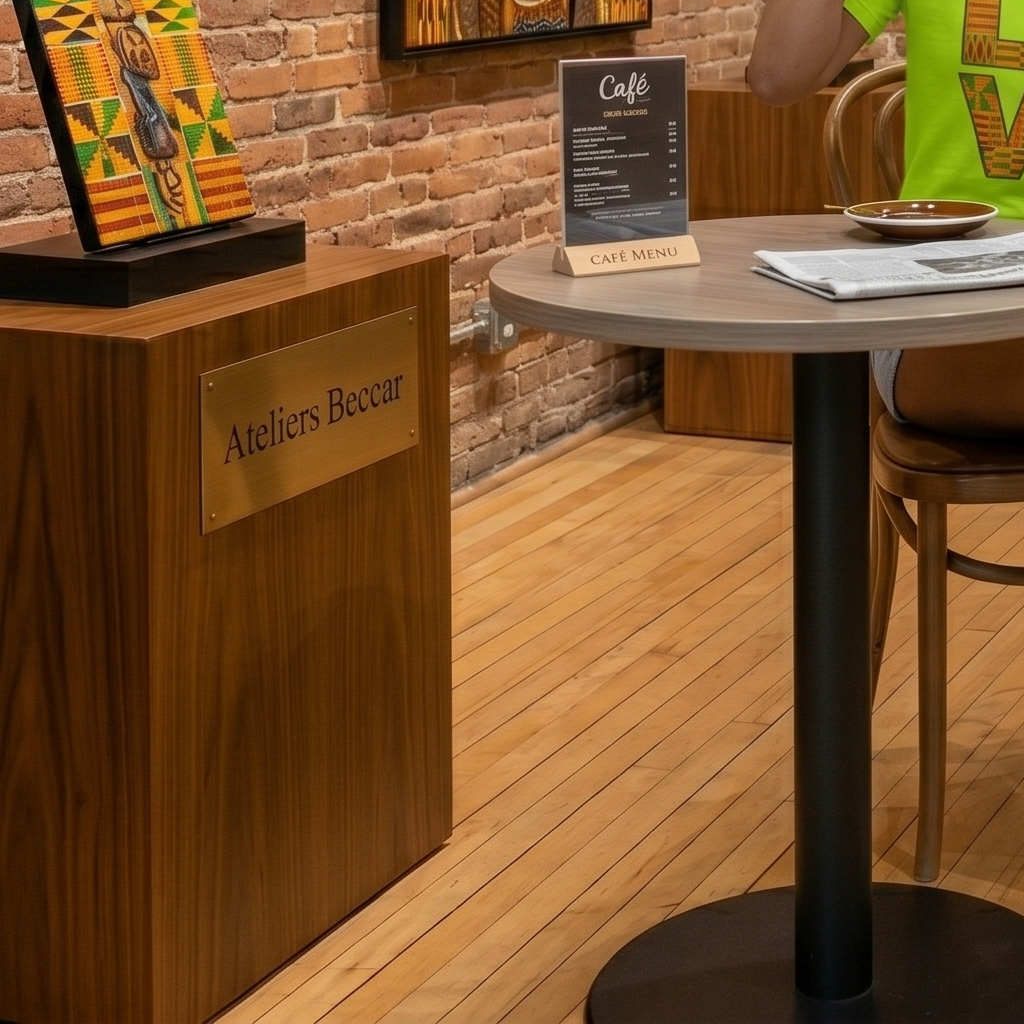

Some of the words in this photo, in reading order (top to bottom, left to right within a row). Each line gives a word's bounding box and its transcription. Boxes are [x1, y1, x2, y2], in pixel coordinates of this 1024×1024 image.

[599, 72, 650, 105] Café
[590, 249, 628, 265] CAFÉ
[632, 246, 678, 262] MENU
[223, 406, 320, 465] Ateliers
[327, 374, 403, 425] Beccar
